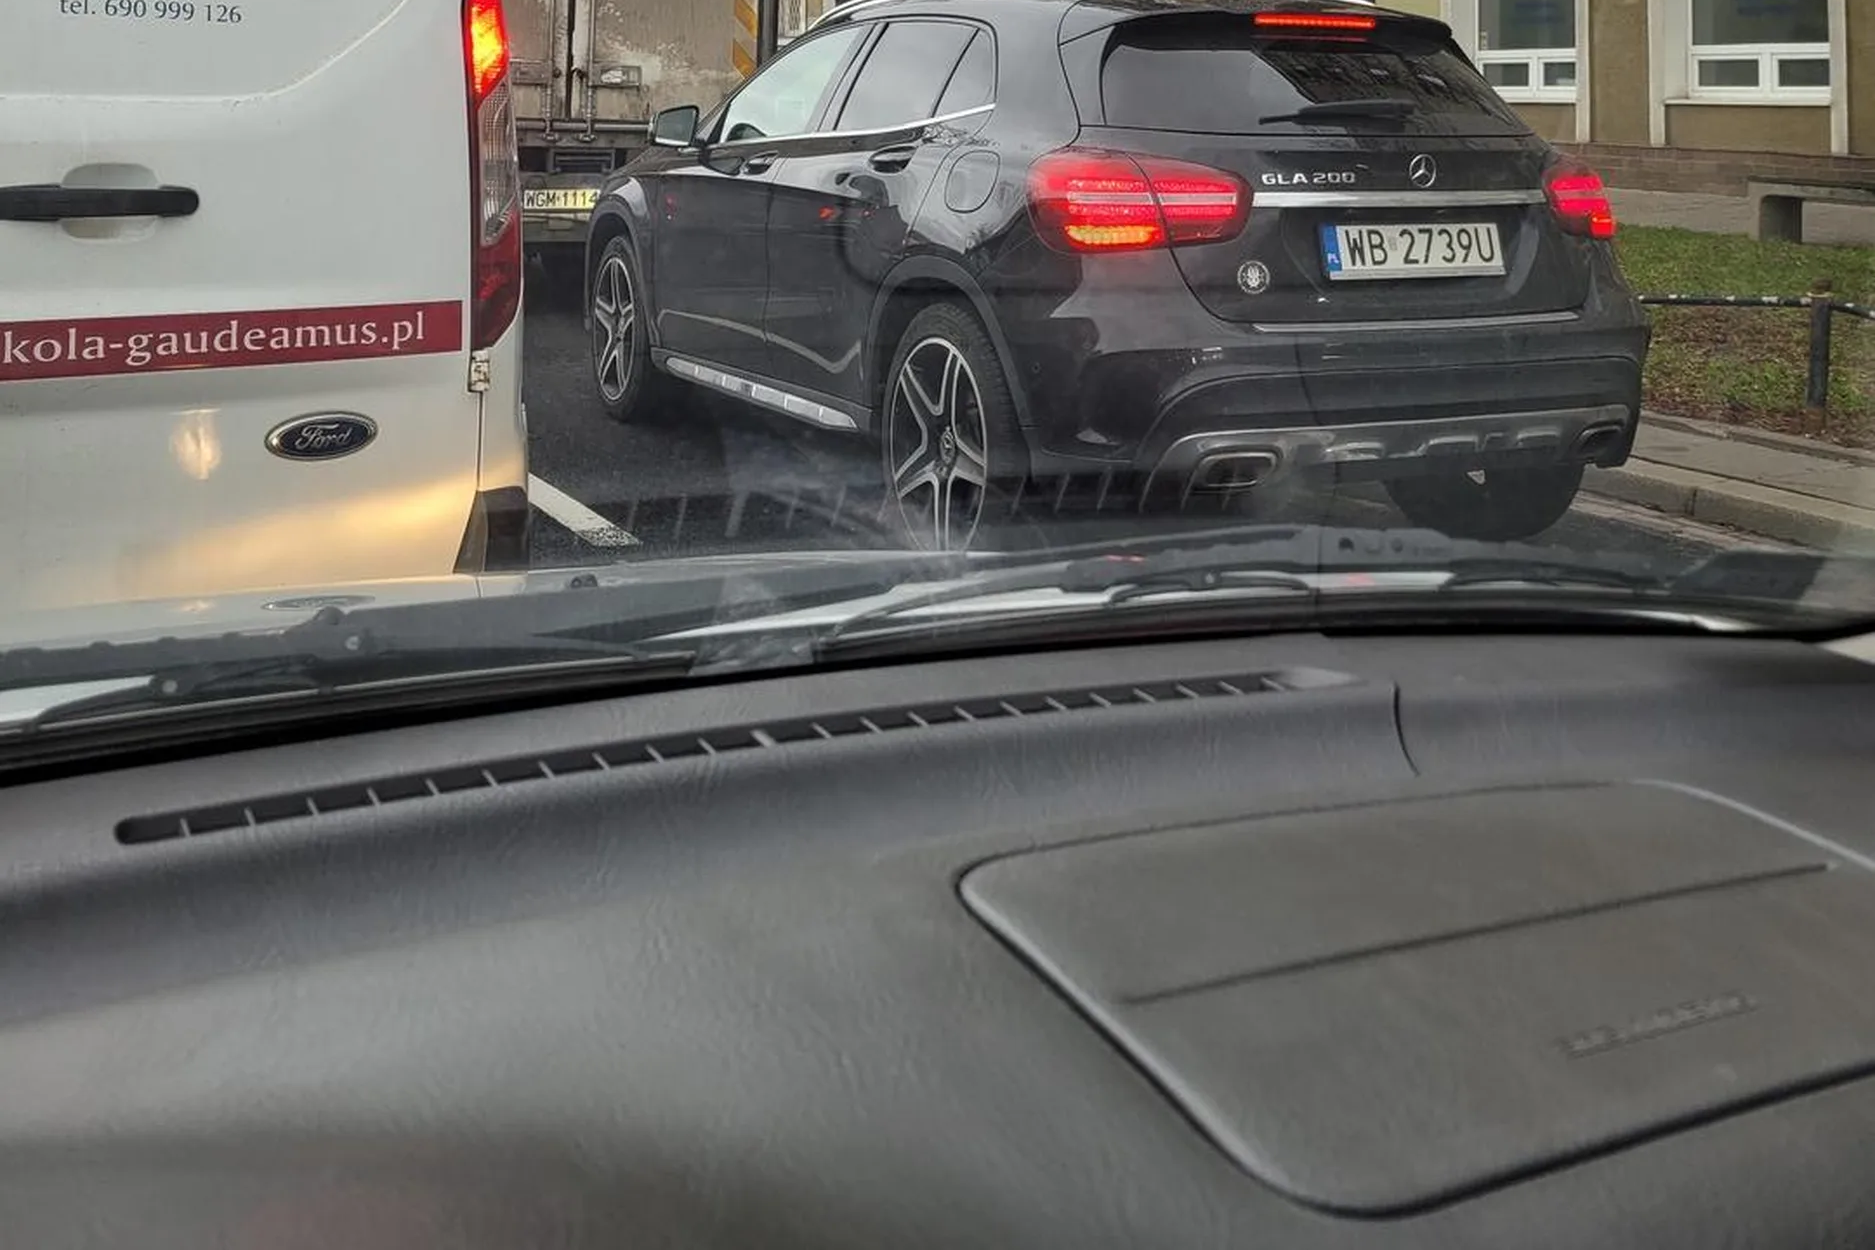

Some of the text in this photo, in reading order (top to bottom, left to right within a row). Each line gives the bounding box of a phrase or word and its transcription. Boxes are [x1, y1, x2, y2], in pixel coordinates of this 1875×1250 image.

[153, 0, 195, 21] 999
[204, 3, 242, 24] 126
[1261, 171, 1356, 185] GLA 200
[1344, 227, 1495, 268] WB 2739U
[295, 423, 353, 450] Ford
